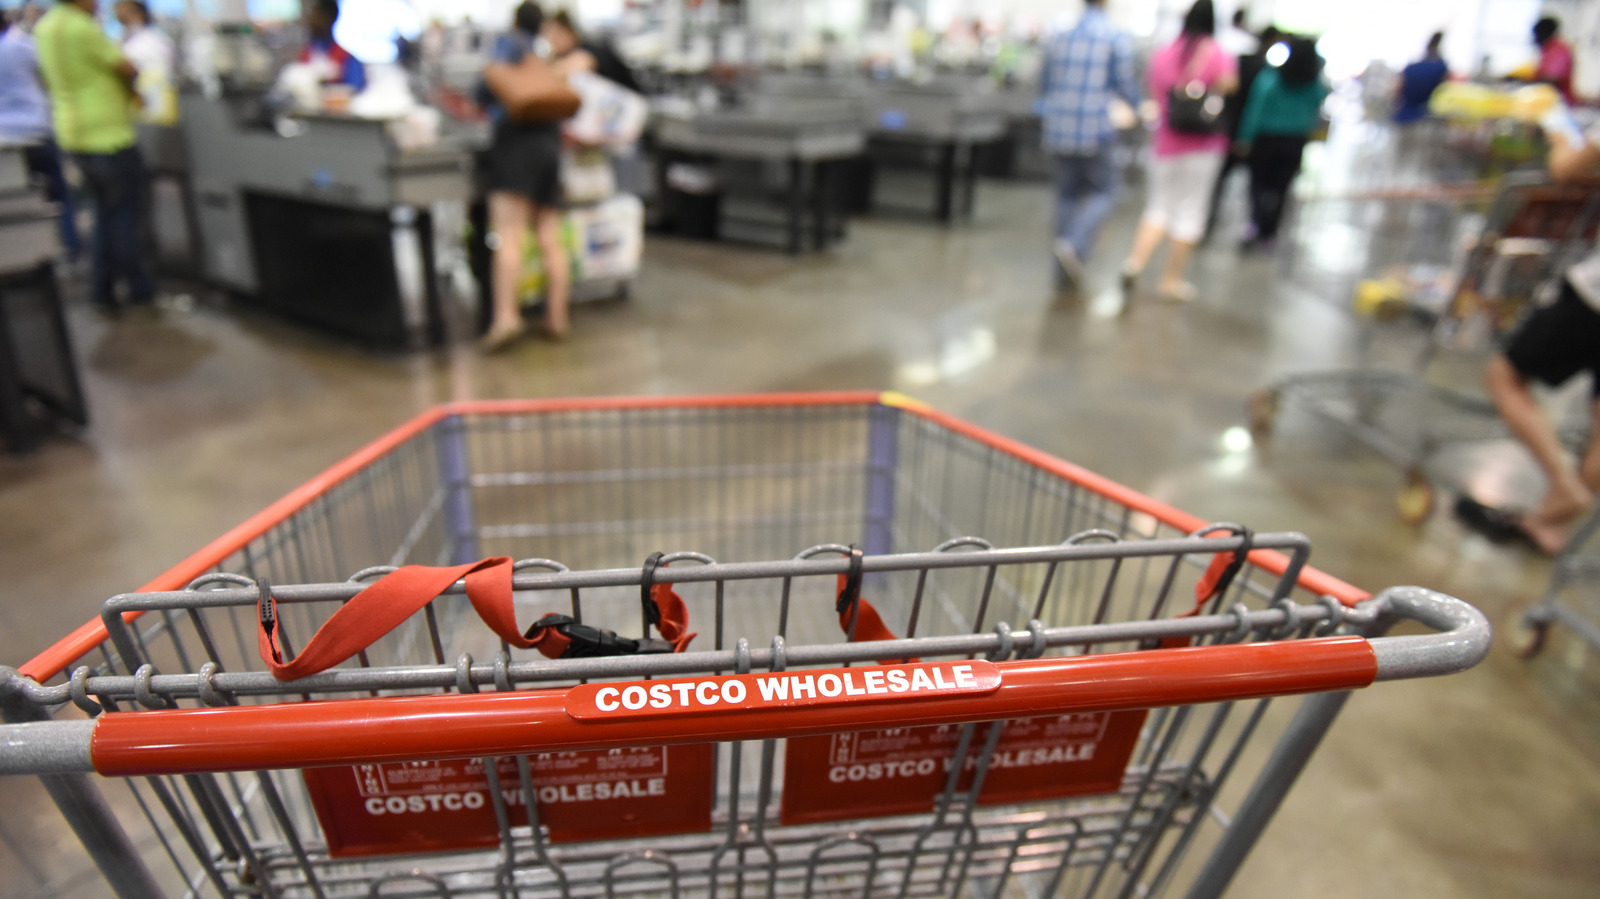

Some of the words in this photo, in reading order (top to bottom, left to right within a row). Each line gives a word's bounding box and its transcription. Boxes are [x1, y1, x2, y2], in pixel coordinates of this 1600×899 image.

[594, 680, 747, 712] COSTCO
[756, 664, 977, 702] WHOLESALE
[829, 759, 936, 783] COSTCO
[943, 742, 1097, 772] WHOLESALE
[365, 792, 485, 816] COSTCO
[496, 779, 666, 807] WHOLESALE
